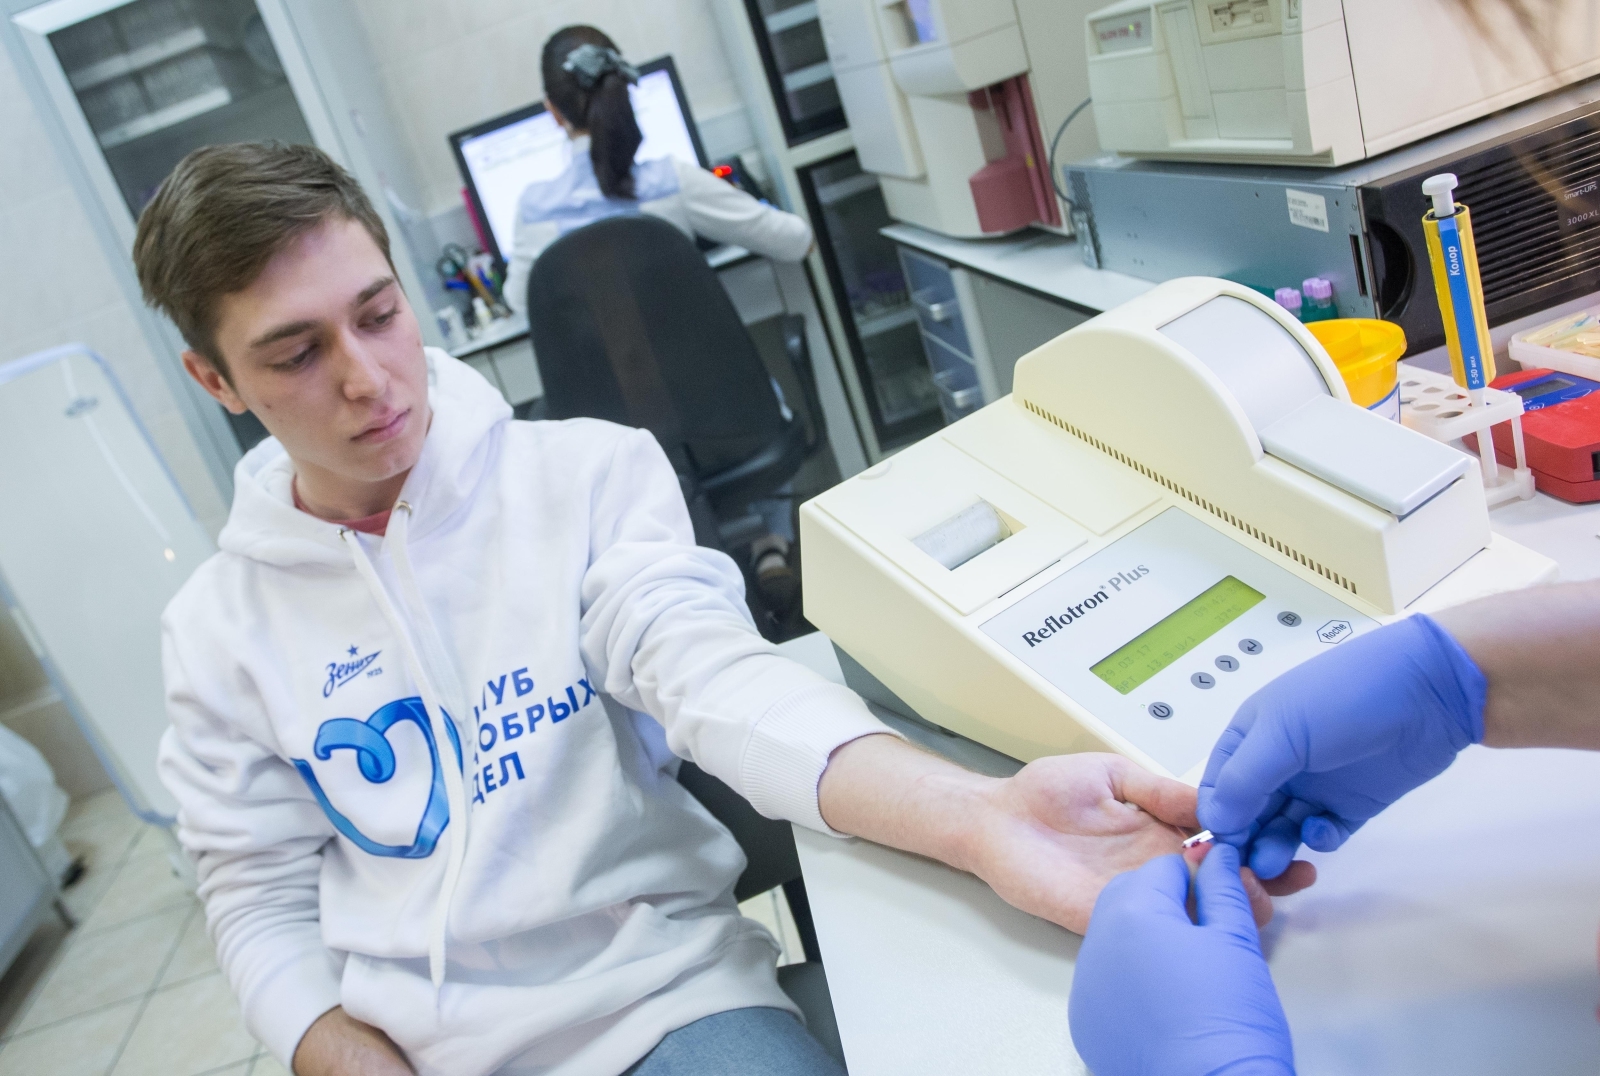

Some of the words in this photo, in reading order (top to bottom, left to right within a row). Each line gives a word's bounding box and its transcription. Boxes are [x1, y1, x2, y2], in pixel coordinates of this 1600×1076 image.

[1563, 183, 1597, 200] Smart-UPS
[1448, 245, 1461, 276] Колор
[1470, 369, 1480, 385] 5-50
[1107, 564, 1150, 592] Plus
[1322, 623, 1347, 640] Roche
[1114, 675, 1138, 693] GPT
[474, 678, 597, 764] ОБРЫХ
